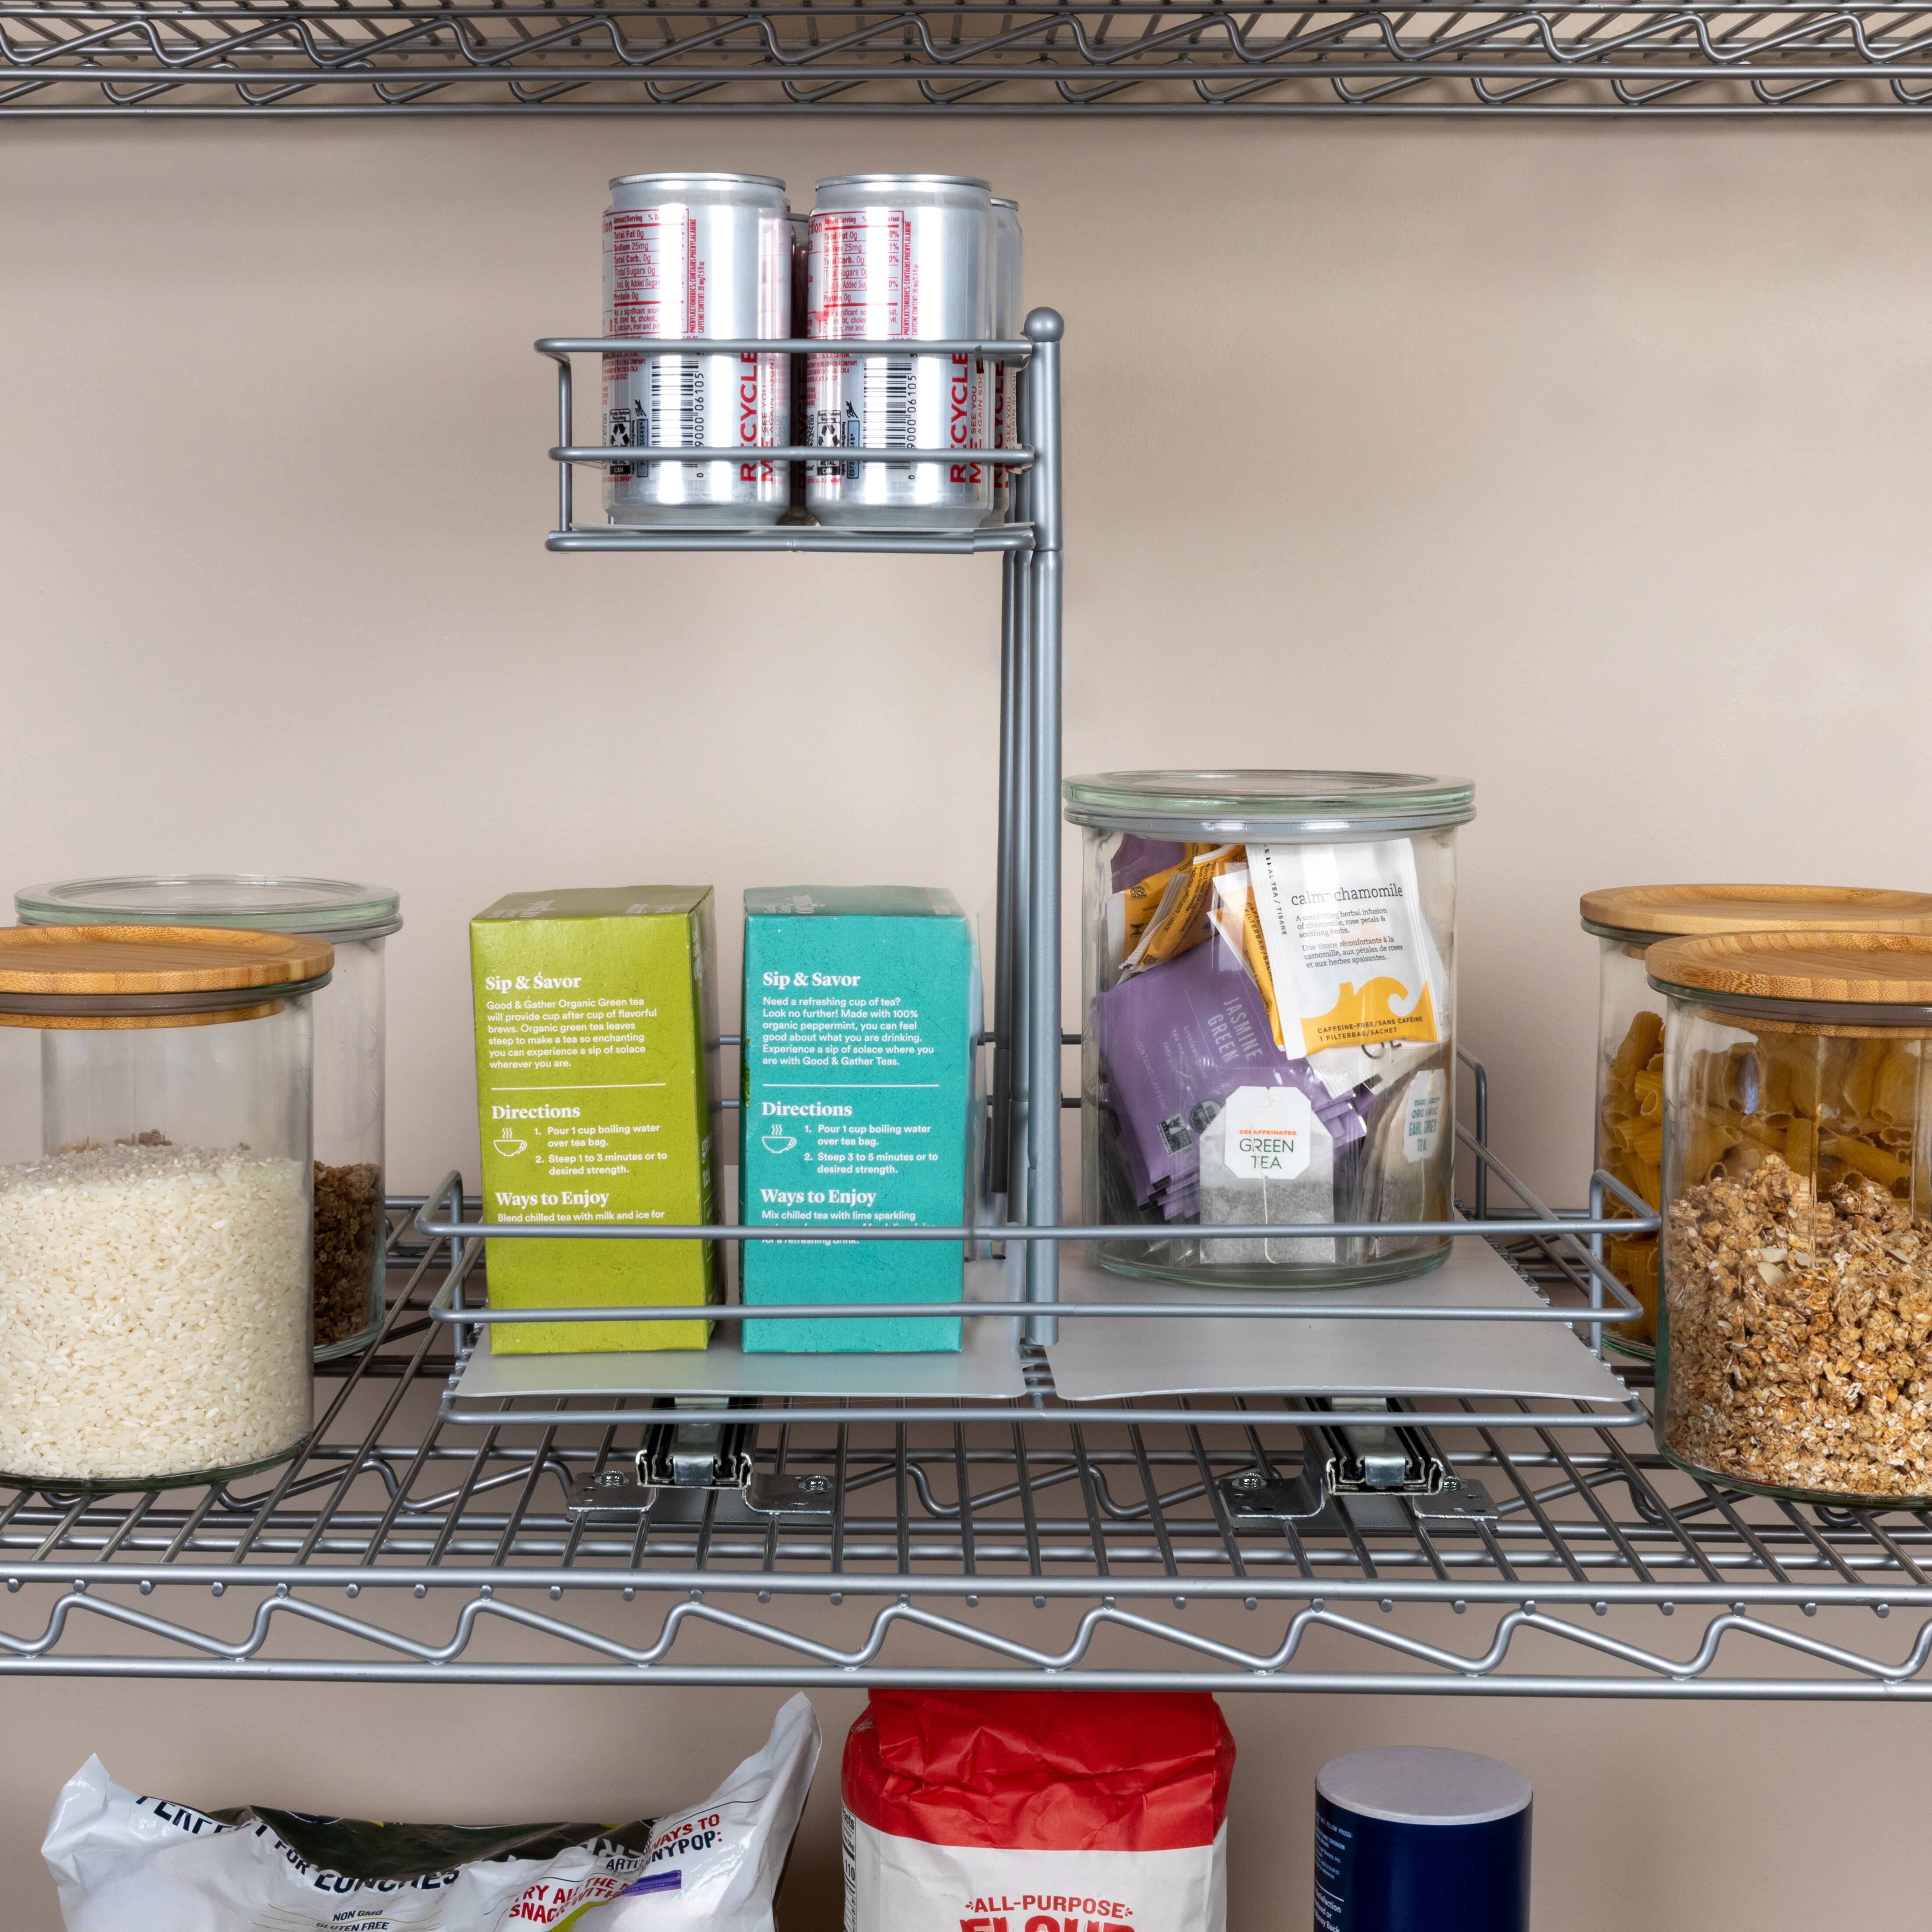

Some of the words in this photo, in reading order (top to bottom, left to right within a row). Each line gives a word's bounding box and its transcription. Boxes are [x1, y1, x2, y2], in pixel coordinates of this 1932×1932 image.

[614, 231, 624, 239] Total
[637, 229, 644, 239] 0g
[632, 242, 648, 251] 25mg
[627, 267, 645, 276] Sugars
[648, 266, 655, 276] 0g
[632, 292, 639, 301] 0g
[695, 373, 704, 411] 06105
[907, 375, 917, 413] 06105
[740, 352, 757, 482] RCYCLE
[950, 352, 968, 483] RCYCLE
[1334, 883, 1403, 901] chamomile
[1276, 907, 1287, 935] TISANE
[1303, 912, 1339, 921] comforting
[1340, 909, 1361, 918] herbal
[1362, 907, 1388, 916] infusion
[1360, 916, 1379, 925] petals
[1299, 929, 1330, 938] soothing
[1340, 937, 1382, 947] réconfortante
[1304, 950, 1341, 960] camomille,
[1356, 946, 1378, 955] pétales
[1329, 957, 1351, 966] herbes
[1352, 954, 1387, 964] apaisantes.
[485, 975, 513, 994] Sip
[514, 975, 530, 990] &
[533, 975, 581, 989] Savor
[763, 971, 790, 990] Sip
[792, 971, 809, 986] &
[812, 972, 860, 986] Savor
[486, 1000, 513, 1010] Good
[514, 1000, 522, 1009] &
[523, 1000, 556, 1009] Gather
[558, 998, 595, 1009] Organic
[598, 997, 627, 1007] Green
[763, 996, 788, 1005] Need
[799, 996, 846, 1008] refreshing
[848, 999, 867, 1007] cup
[868, 997, 878, 1006] of
[880, 997, 900, 1006] tea?
[487, 1012, 503, 1021] will
[505, 1011, 540, 1023] provide
[541, 1013, 560, 1022] cup
[561, 1011, 584, 1020] after
[606, 1009, 616, 1018] of
[617, 1008, 657, 1018] flavorful
[763, 1008, 786, 1017] Look
[802, 1008, 838, 1018] further!
[840, 1009, 868, 1018] Made
[870, 1009, 890, 1018] with
[893, 1009, 918, 1018] 100%
[1223, 997, 1263, 1060] JASMINE
[1317, 1018, 1395, 1034] CAFFEINE-FREE/SANS
[1397, 1016, 1423, 1024] CAFÉINE
[1208, 1014, 1239, 1062] GREEN
[1326, 1026, 1397, 1041] FILTERBAG/SACHET
[491, 1103, 580, 1119] Directions
[761, 1100, 852, 1116] Directions
[817, 1124, 840, 1133] Pour
[848, 1126, 867, 1135] cup
[868, 1124, 901, 1135] boiling
[903, 1125, 931, 1133] water
[840, 1137, 856, 1145] tea
[858, 1136, 879, 1147] bag.
[1239, 1138, 1294, 1153] GREEN
[535, 1155, 544, 1163] 2.
[548, 1154, 577, 1164] Steep
[596, 1153, 603, 1161] 3
[605, 1152, 643, 1161] minutes
[1251, 1155, 1282, 1169] TEA
[495, 1192, 538, 1209] Ways
[540, 1193, 559, 1205] to
[561, 1189, 609, 1208] Enjoy
[760, 1188, 804, 1207] Ways
[806, 1190, 825, 1203] to
[828, 1188, 876, 1207] Enjoy
[697, 1814, 720, 1830] TO
[845, 1859, 855, 1882] 110
[585, 1877, 618, 1889] THE
[974, 1894, 1126, 1919] ALL-PURPOSE
[333, 1910, 356, 1921] NON
[316, 1922, 359, 1931] GLUTEN
[361, 1921, 390, 1931] FREE
